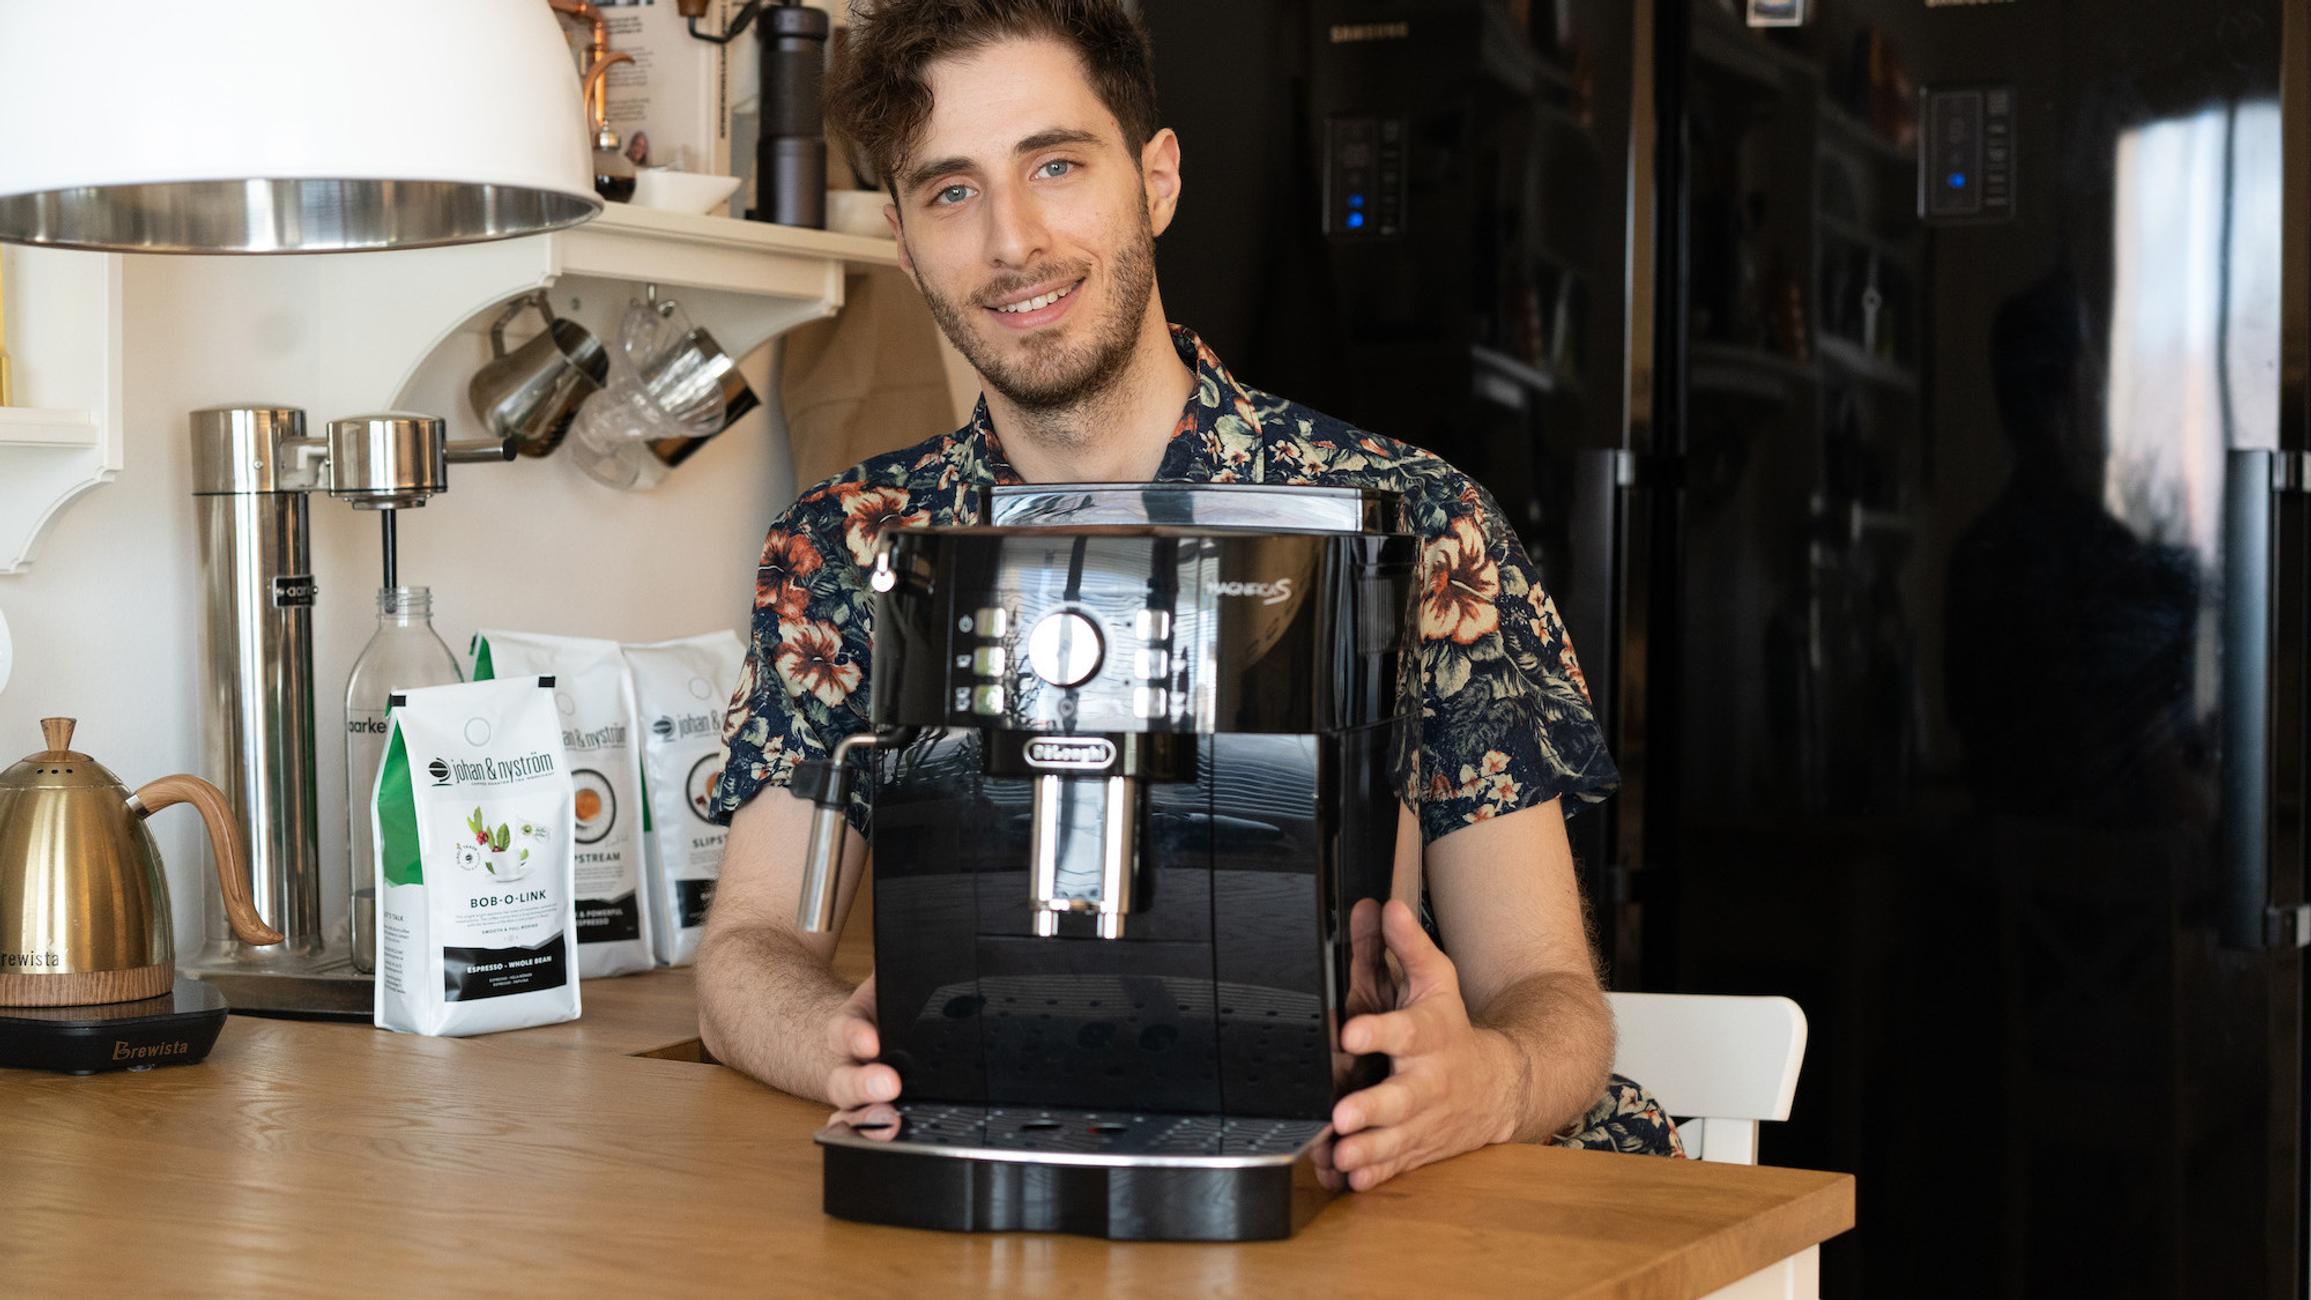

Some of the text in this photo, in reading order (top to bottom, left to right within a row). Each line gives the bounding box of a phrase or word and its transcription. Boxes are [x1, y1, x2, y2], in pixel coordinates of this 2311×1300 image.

[451, 751, 554, 784] johan & nyström
[692, 836, 727, 848] SLIPS
[467, 962, 503, 974] ESPRESSO
[508, 958, 533, 969] WHOLE
[534, 955, 552, 965] BEAN
[112, 1039, 189, 1061] Brewista
